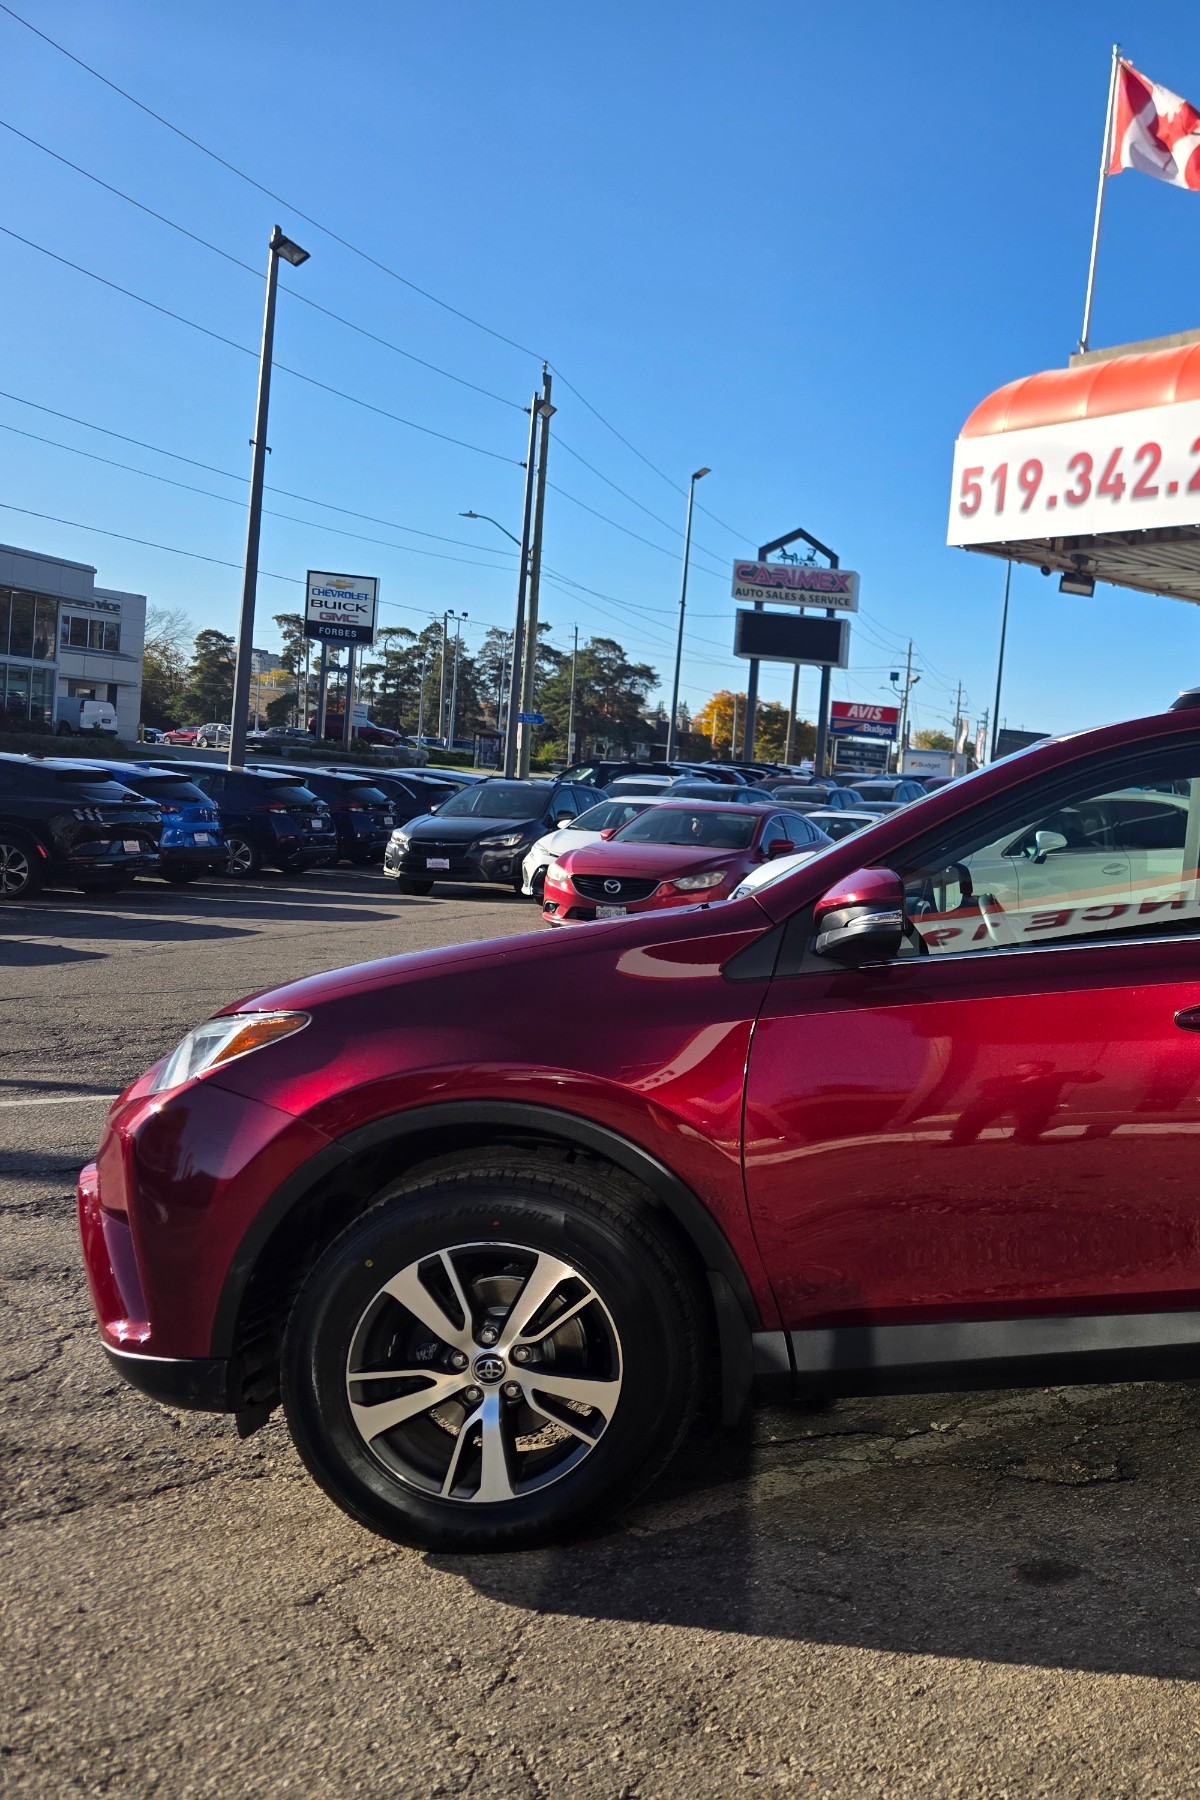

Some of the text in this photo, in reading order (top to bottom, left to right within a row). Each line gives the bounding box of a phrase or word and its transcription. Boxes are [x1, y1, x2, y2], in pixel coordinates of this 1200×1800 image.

[736, 563, 853, 592] CARIMEX
[311, 588, 369, 601] CHEVROLET
[736, 588, 850, 606] AUTO SALES & SERVICE
[310, 599, 368, 613] BUICK
[319, 612, 359, 623] GMC
[318, 627, 357, 637] FORBES
[847, 705, 884, 720] AVIS
[863, 723, 893, 736] Budget
[918, 762, 941, 770] Budget
